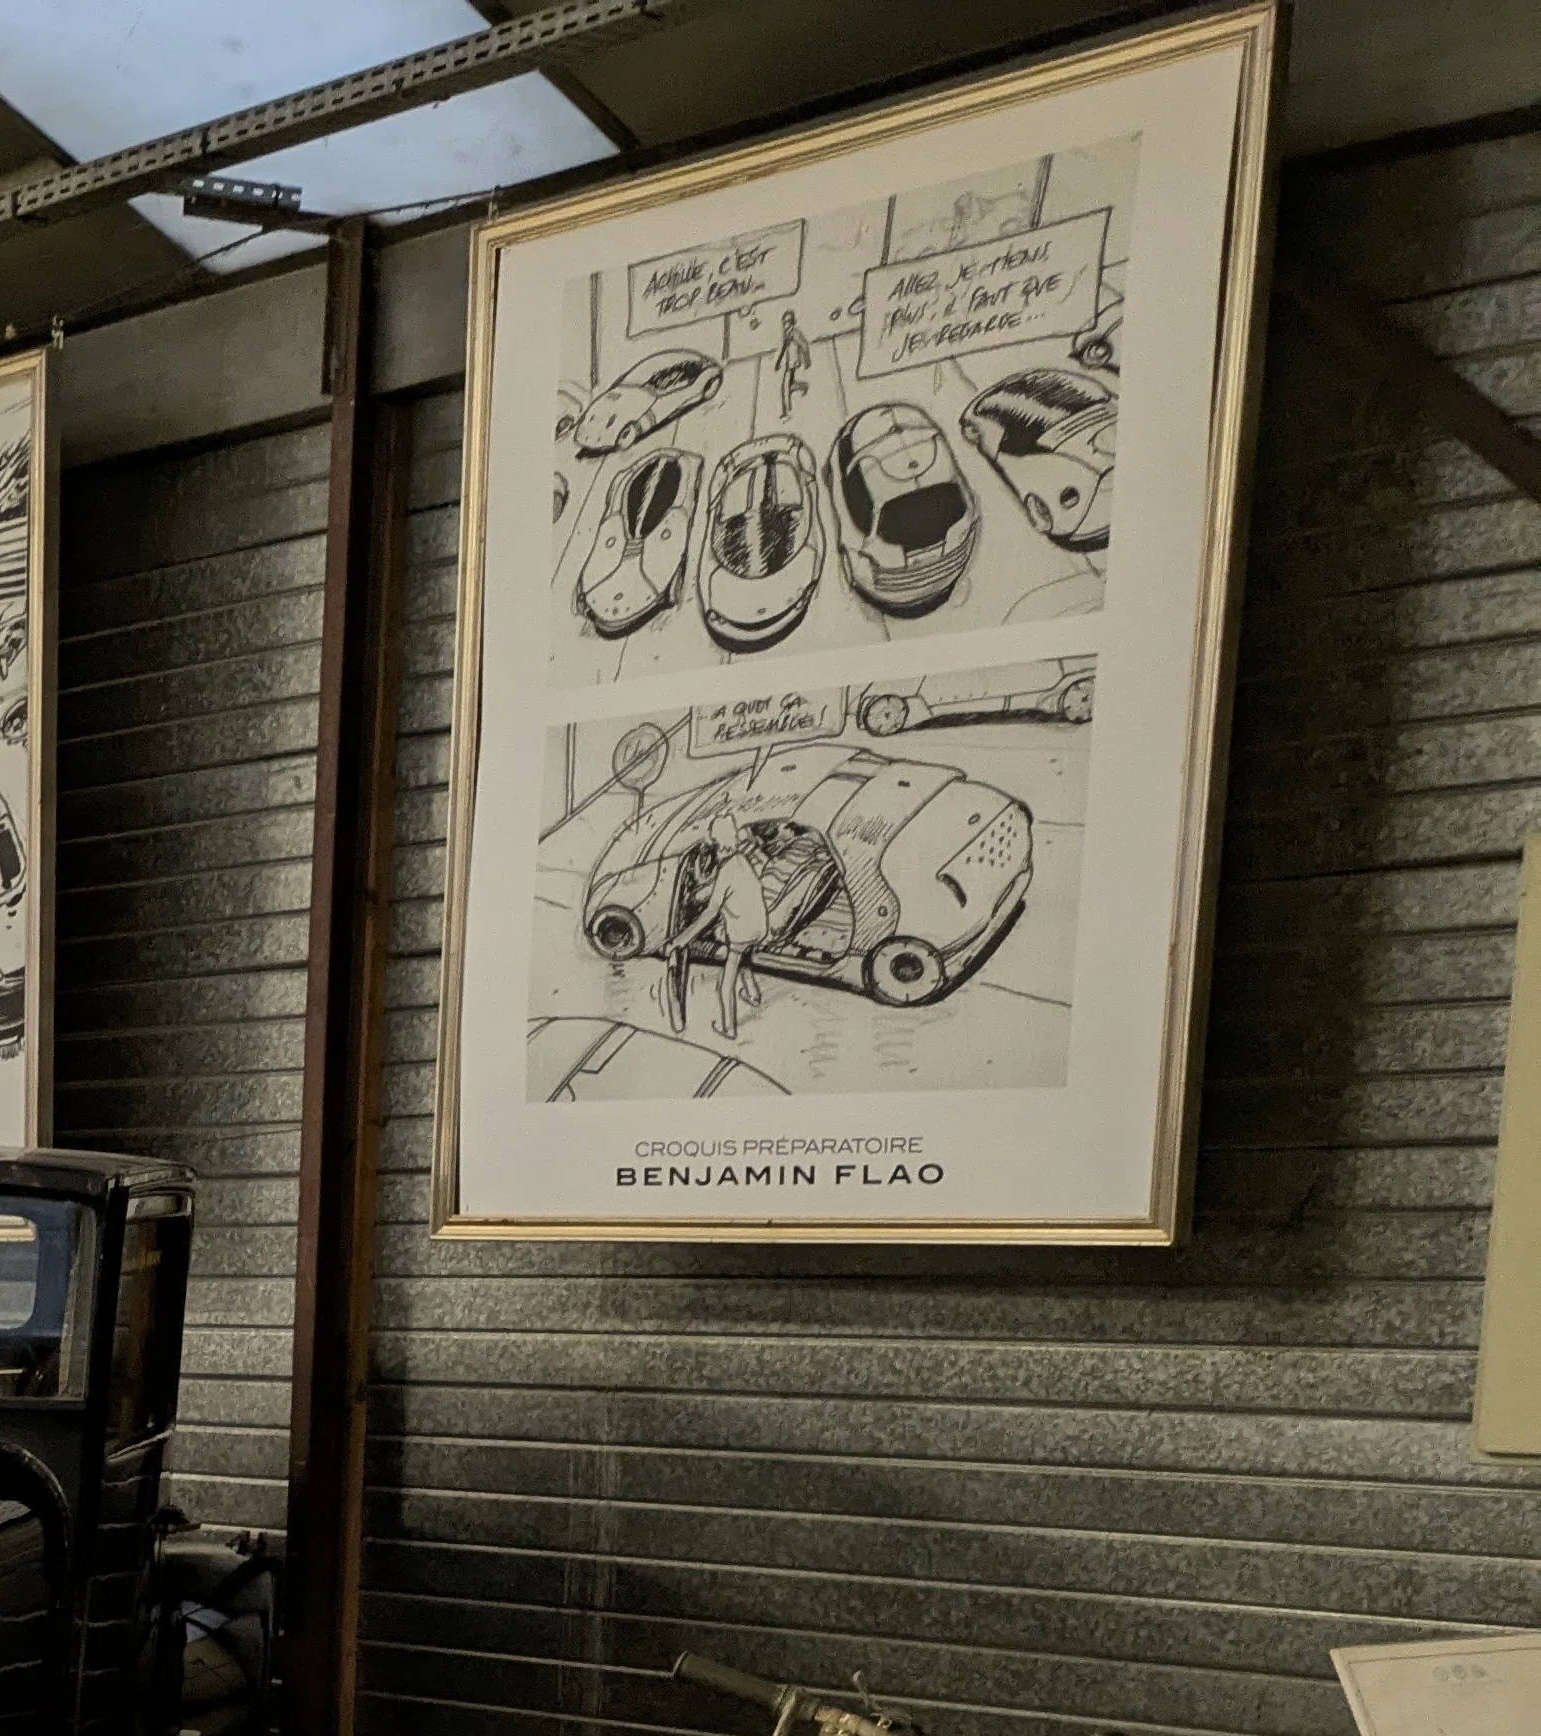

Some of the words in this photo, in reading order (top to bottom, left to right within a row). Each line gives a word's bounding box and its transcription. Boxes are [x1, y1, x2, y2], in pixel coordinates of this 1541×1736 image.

[635, 1141, 737, 1157] CROQUIS
[743, 1136, 924, 1156] PRÉPARATOIRE
[616, 1165, 816, 1187] BENJAMIN
[835, 1163, 945, 1185] FLAO
